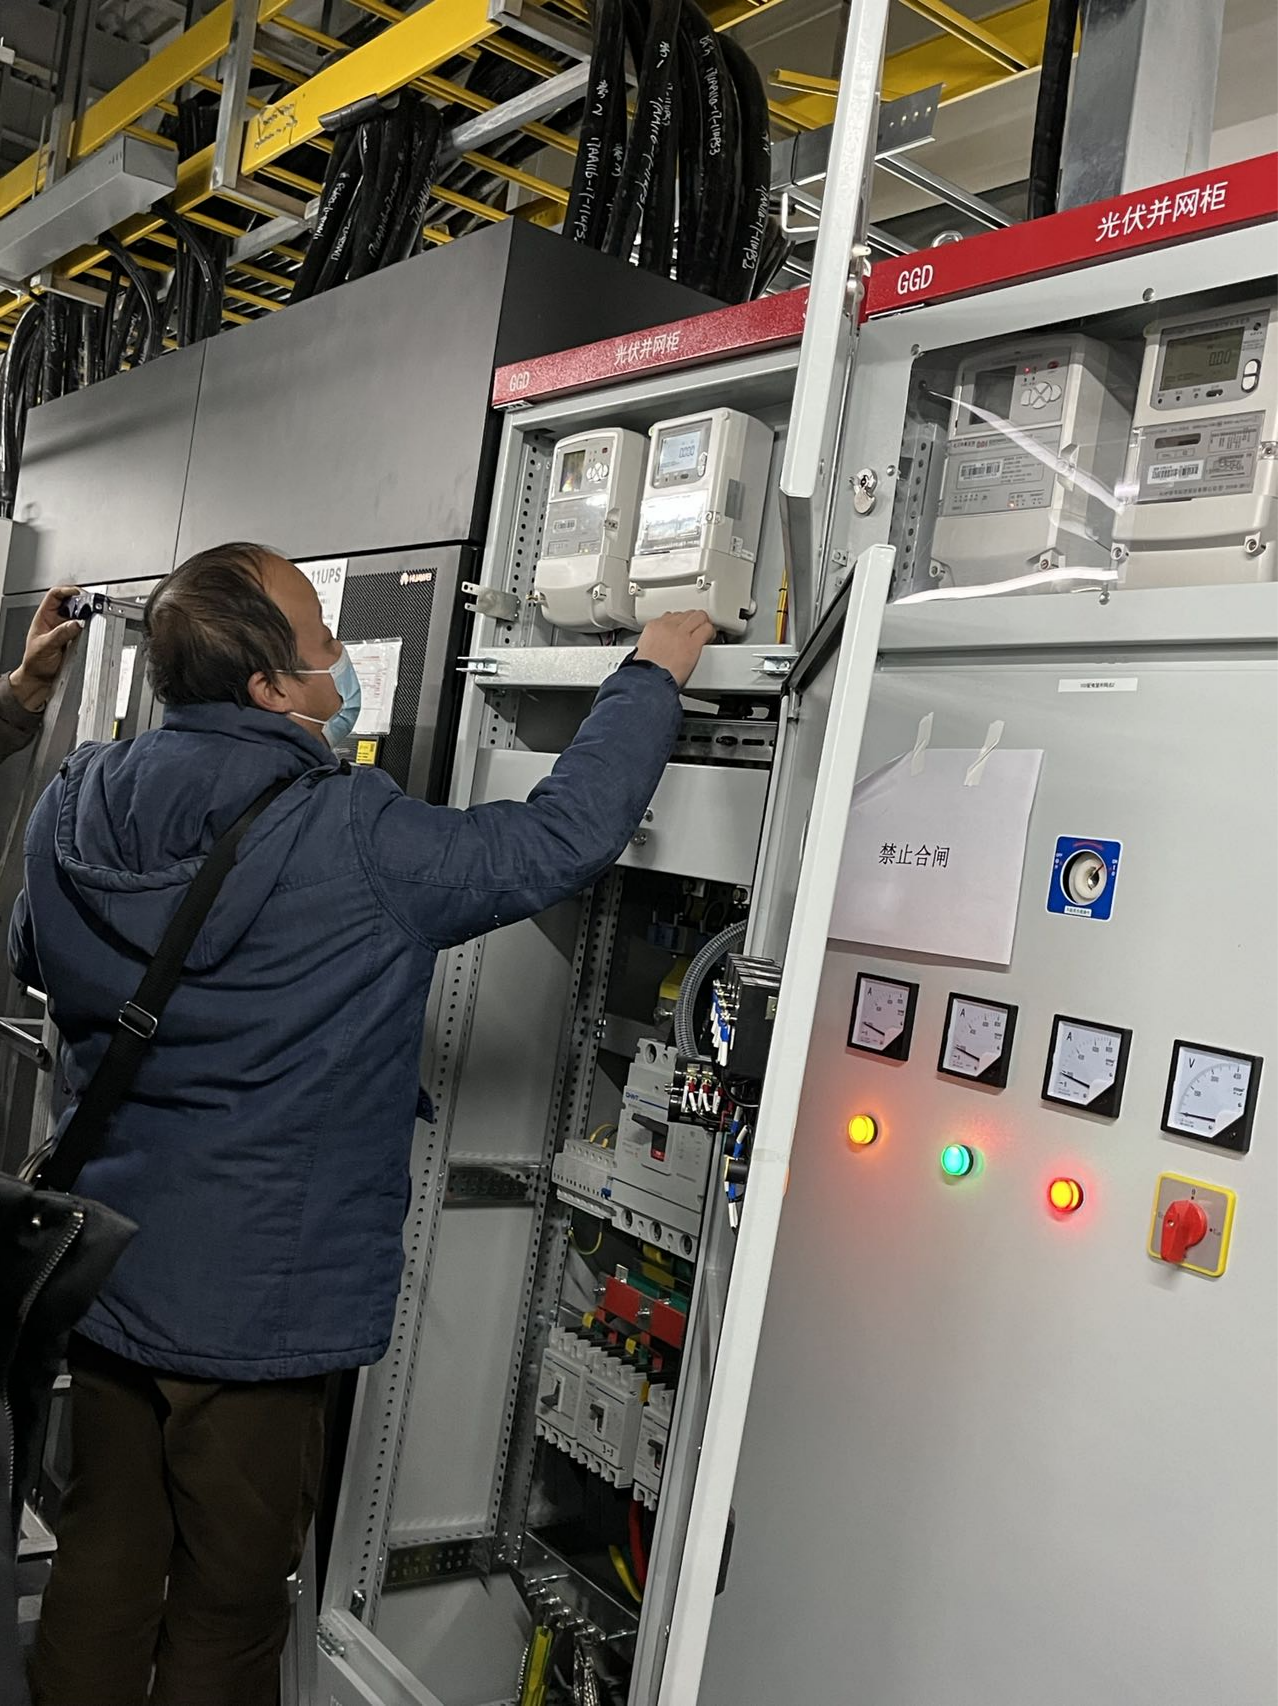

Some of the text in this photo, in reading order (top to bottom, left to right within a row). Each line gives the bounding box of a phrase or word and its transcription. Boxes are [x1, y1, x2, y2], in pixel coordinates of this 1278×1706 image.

[1096, 182, 1228, 241] 光伏并网柜
[897, 264, 934, 295] GGD
[614, 331, 681, 365] 光伏并网柜
[509, 371, 530, 392] GGD
[878, 842, 950, 868] 禁止合闸
[960, 1008, 966, 1017] A
[1066, 1032, 1072, 1041] A
[1189, 1058, 1195, 1068] V
